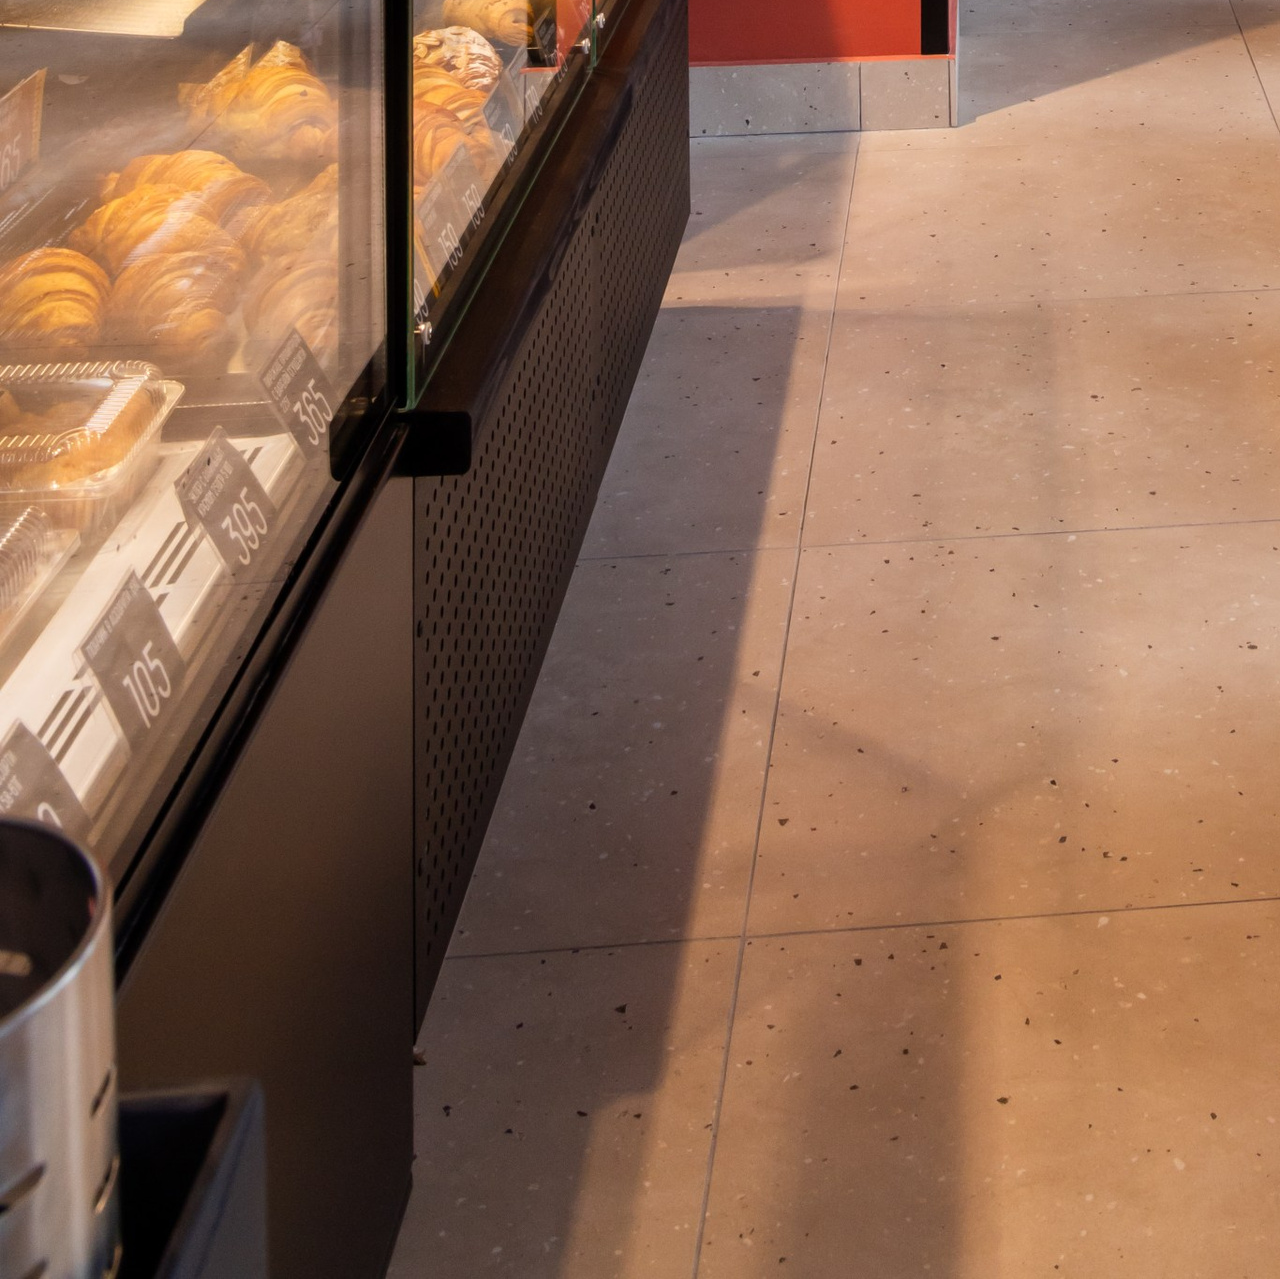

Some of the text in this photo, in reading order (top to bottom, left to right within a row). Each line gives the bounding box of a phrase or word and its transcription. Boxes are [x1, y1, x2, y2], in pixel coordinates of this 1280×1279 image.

[0, 131, 22, 191] 65
[438, 222, 464, 271] 159
[293, 378, 333, 446] 365
[221, 486, 268, 566] 395
[122, 640, 172, 729] 105
